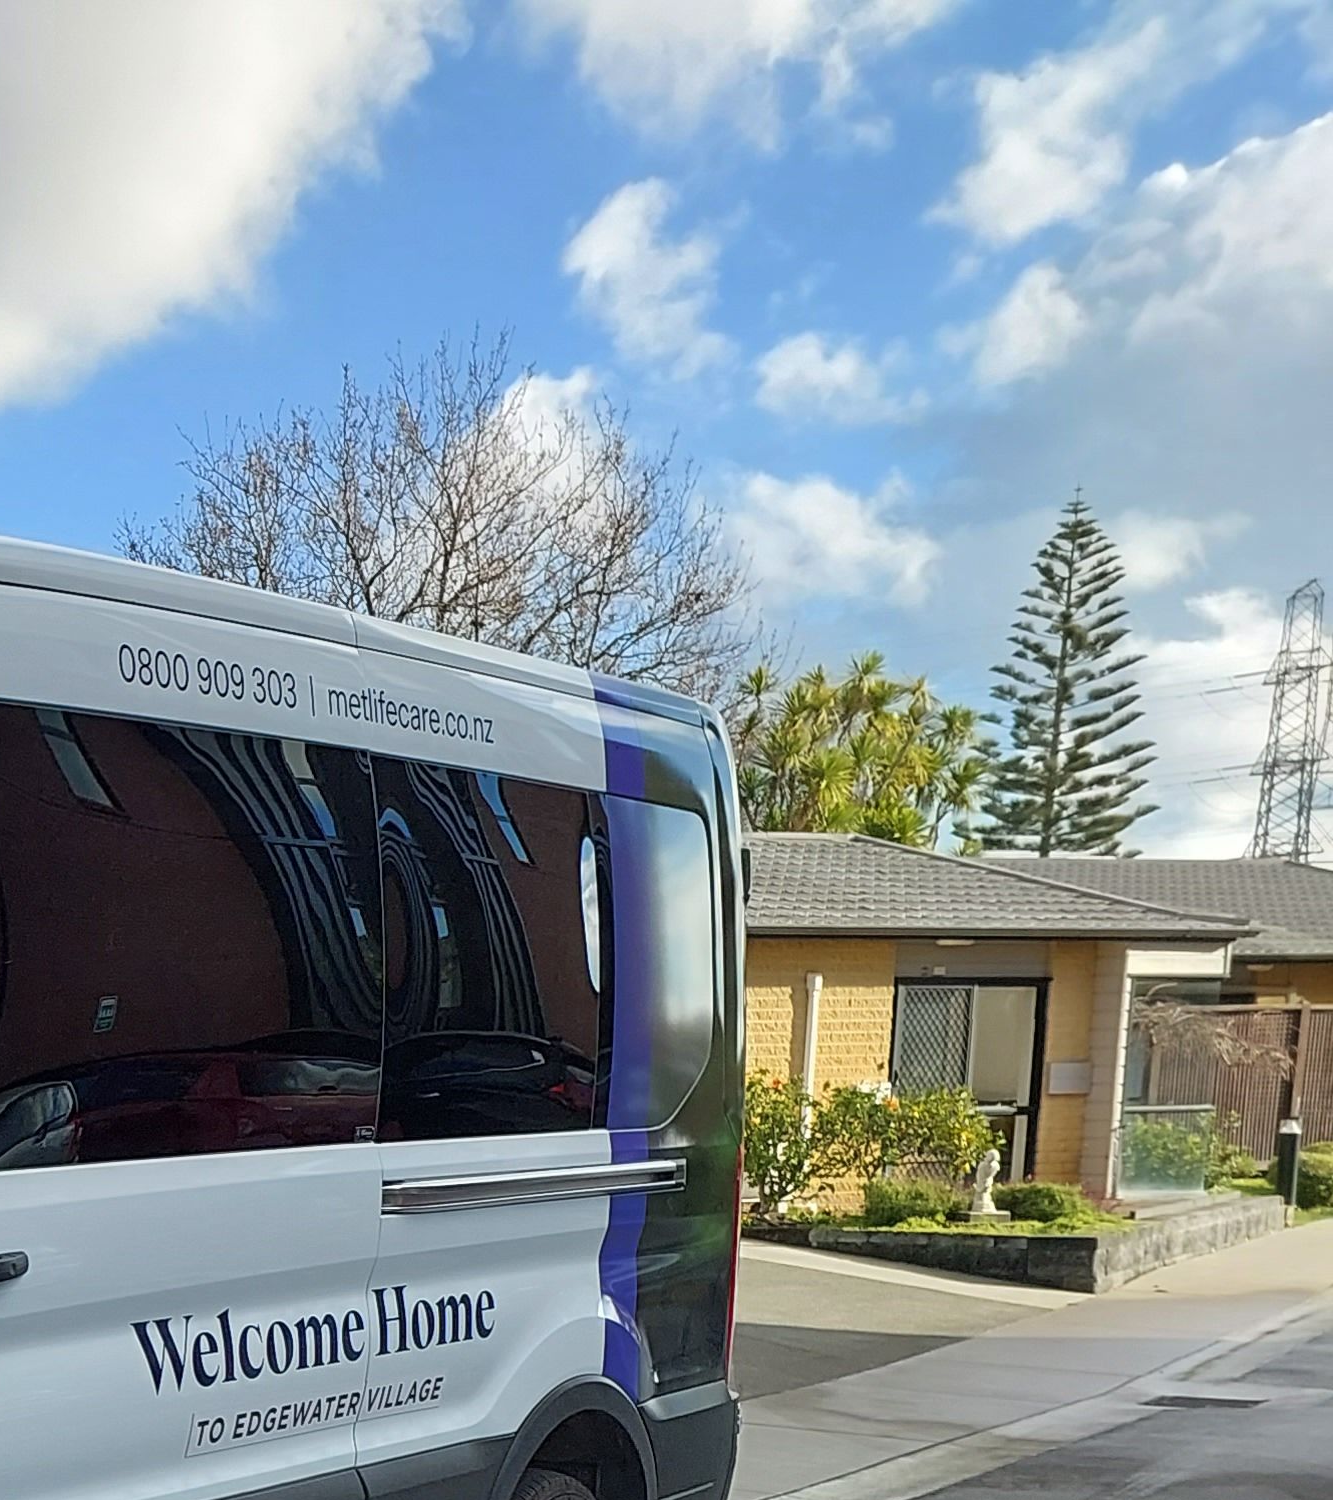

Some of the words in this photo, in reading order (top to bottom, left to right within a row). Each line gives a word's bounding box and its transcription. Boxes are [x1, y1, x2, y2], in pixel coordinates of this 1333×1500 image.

[119, 644, 189, 691] 0800
[197, 658, 245, 700] 909
[252, 667, 296, 708] 303
[328, 688, 495, 744] metlifecare.co.nz
[130, 1309, 365, 1396] Welcome
[372, 1285, 495, 1356] Home
[197, 1418, 225, 1446] TO
[232, 1391, 361, 1439] EDGEWATER
[366, 1376, 444, 1412] VILLAGE
